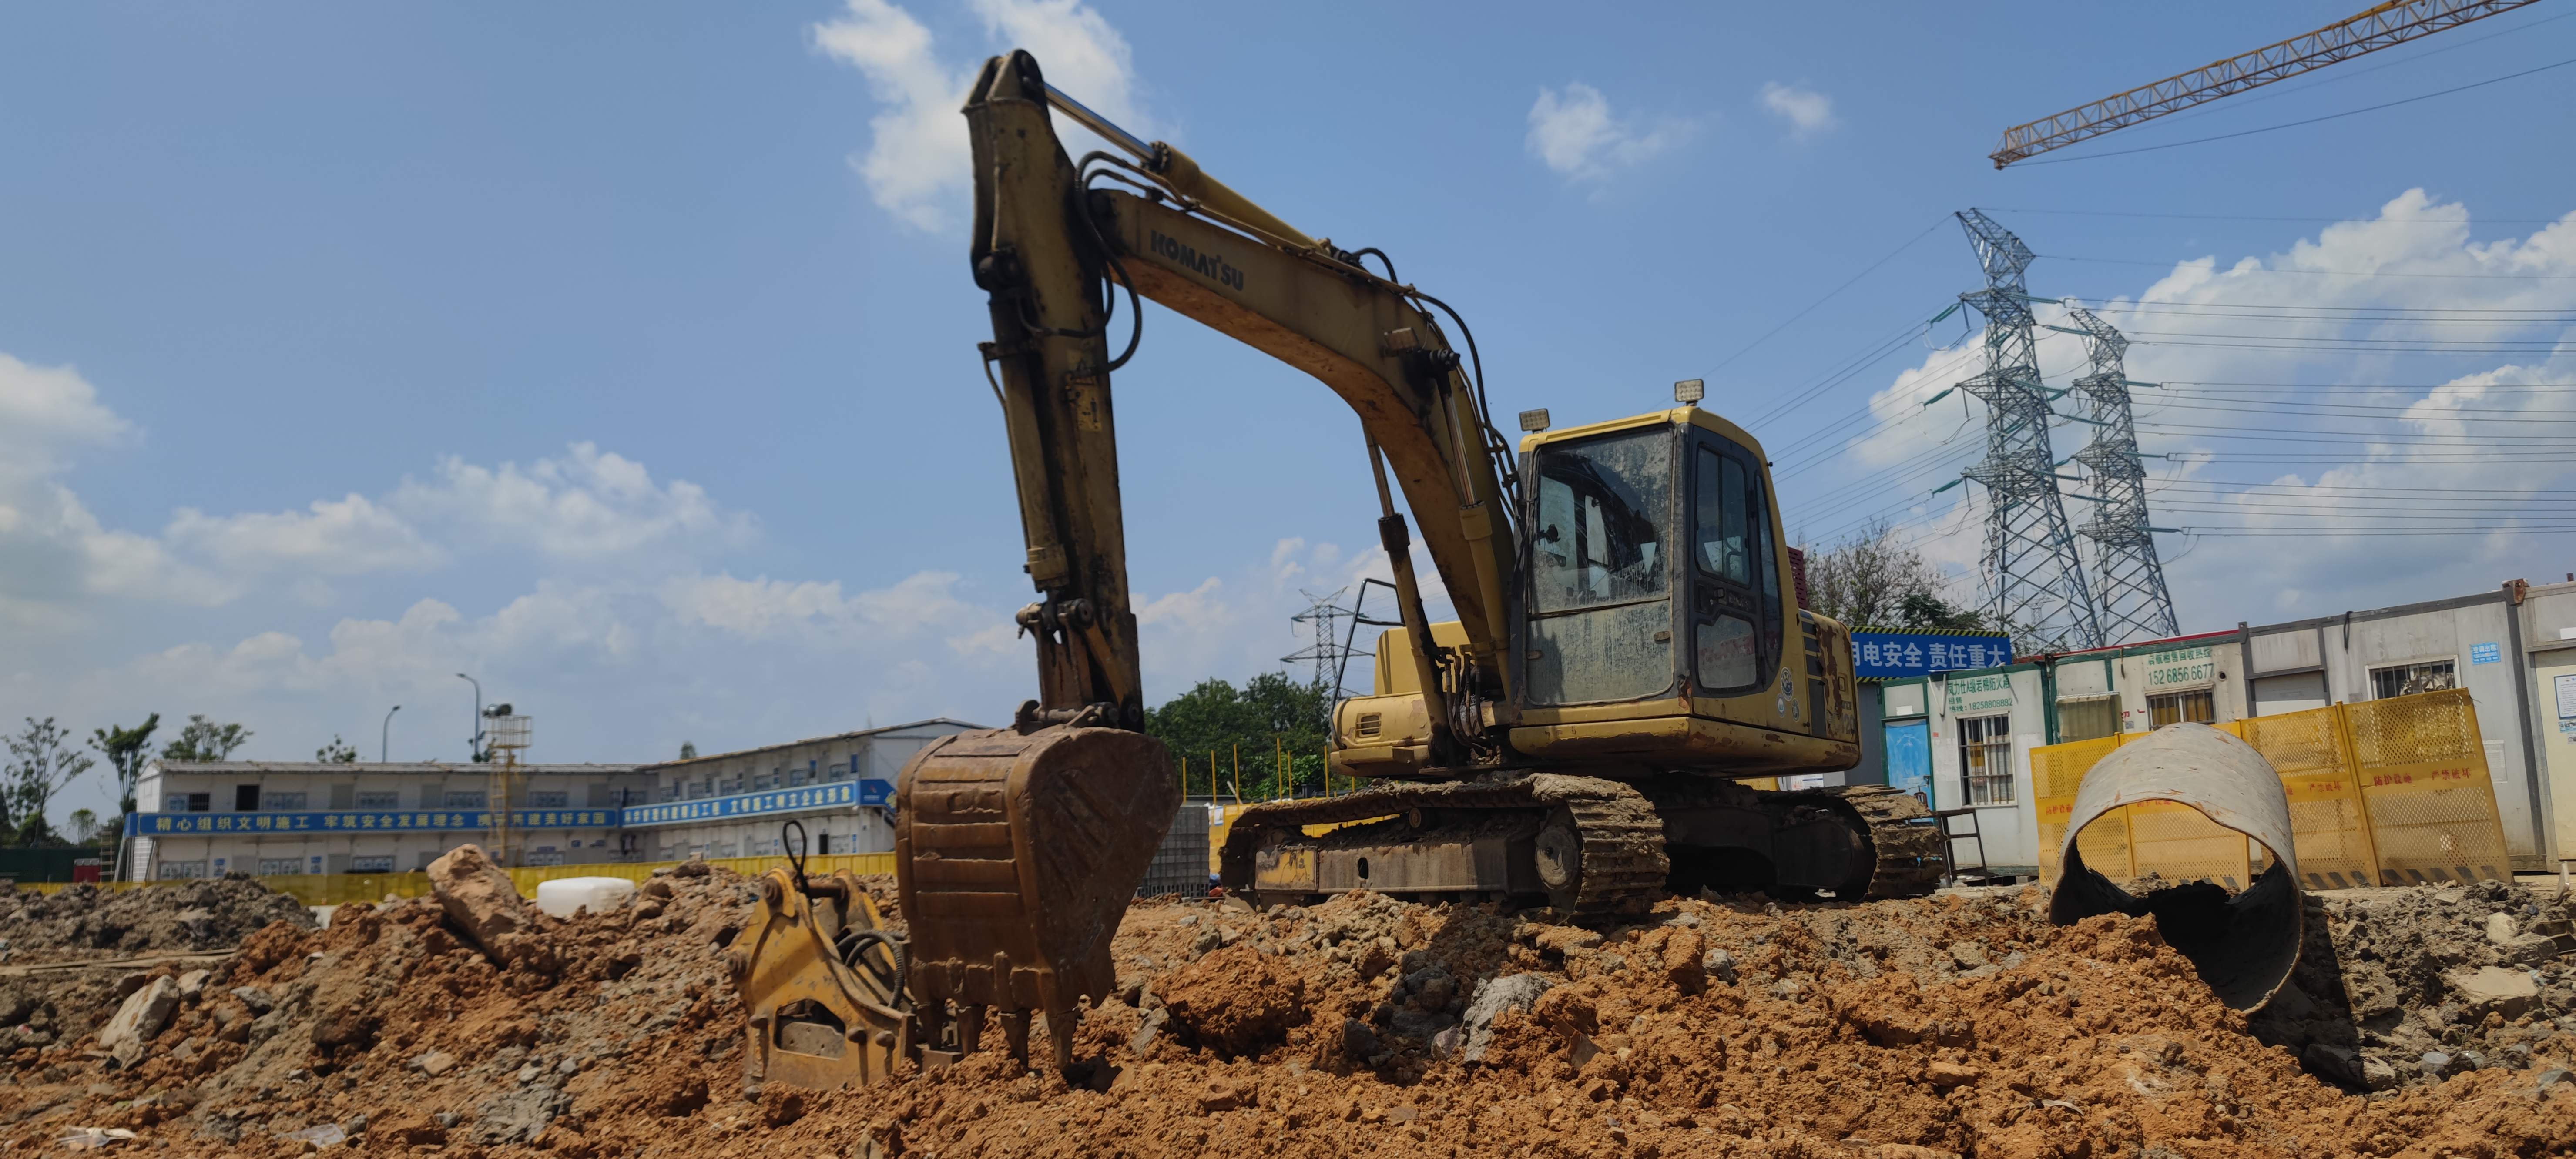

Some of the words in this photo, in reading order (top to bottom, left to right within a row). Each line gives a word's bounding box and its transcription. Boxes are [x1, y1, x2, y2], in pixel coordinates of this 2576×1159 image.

[1150, 229, 1244, 291] KOMATSU
[1928, 642, 2005, 669] 责任重大
[155, 816, 309, 832] 精心组织文明施工
